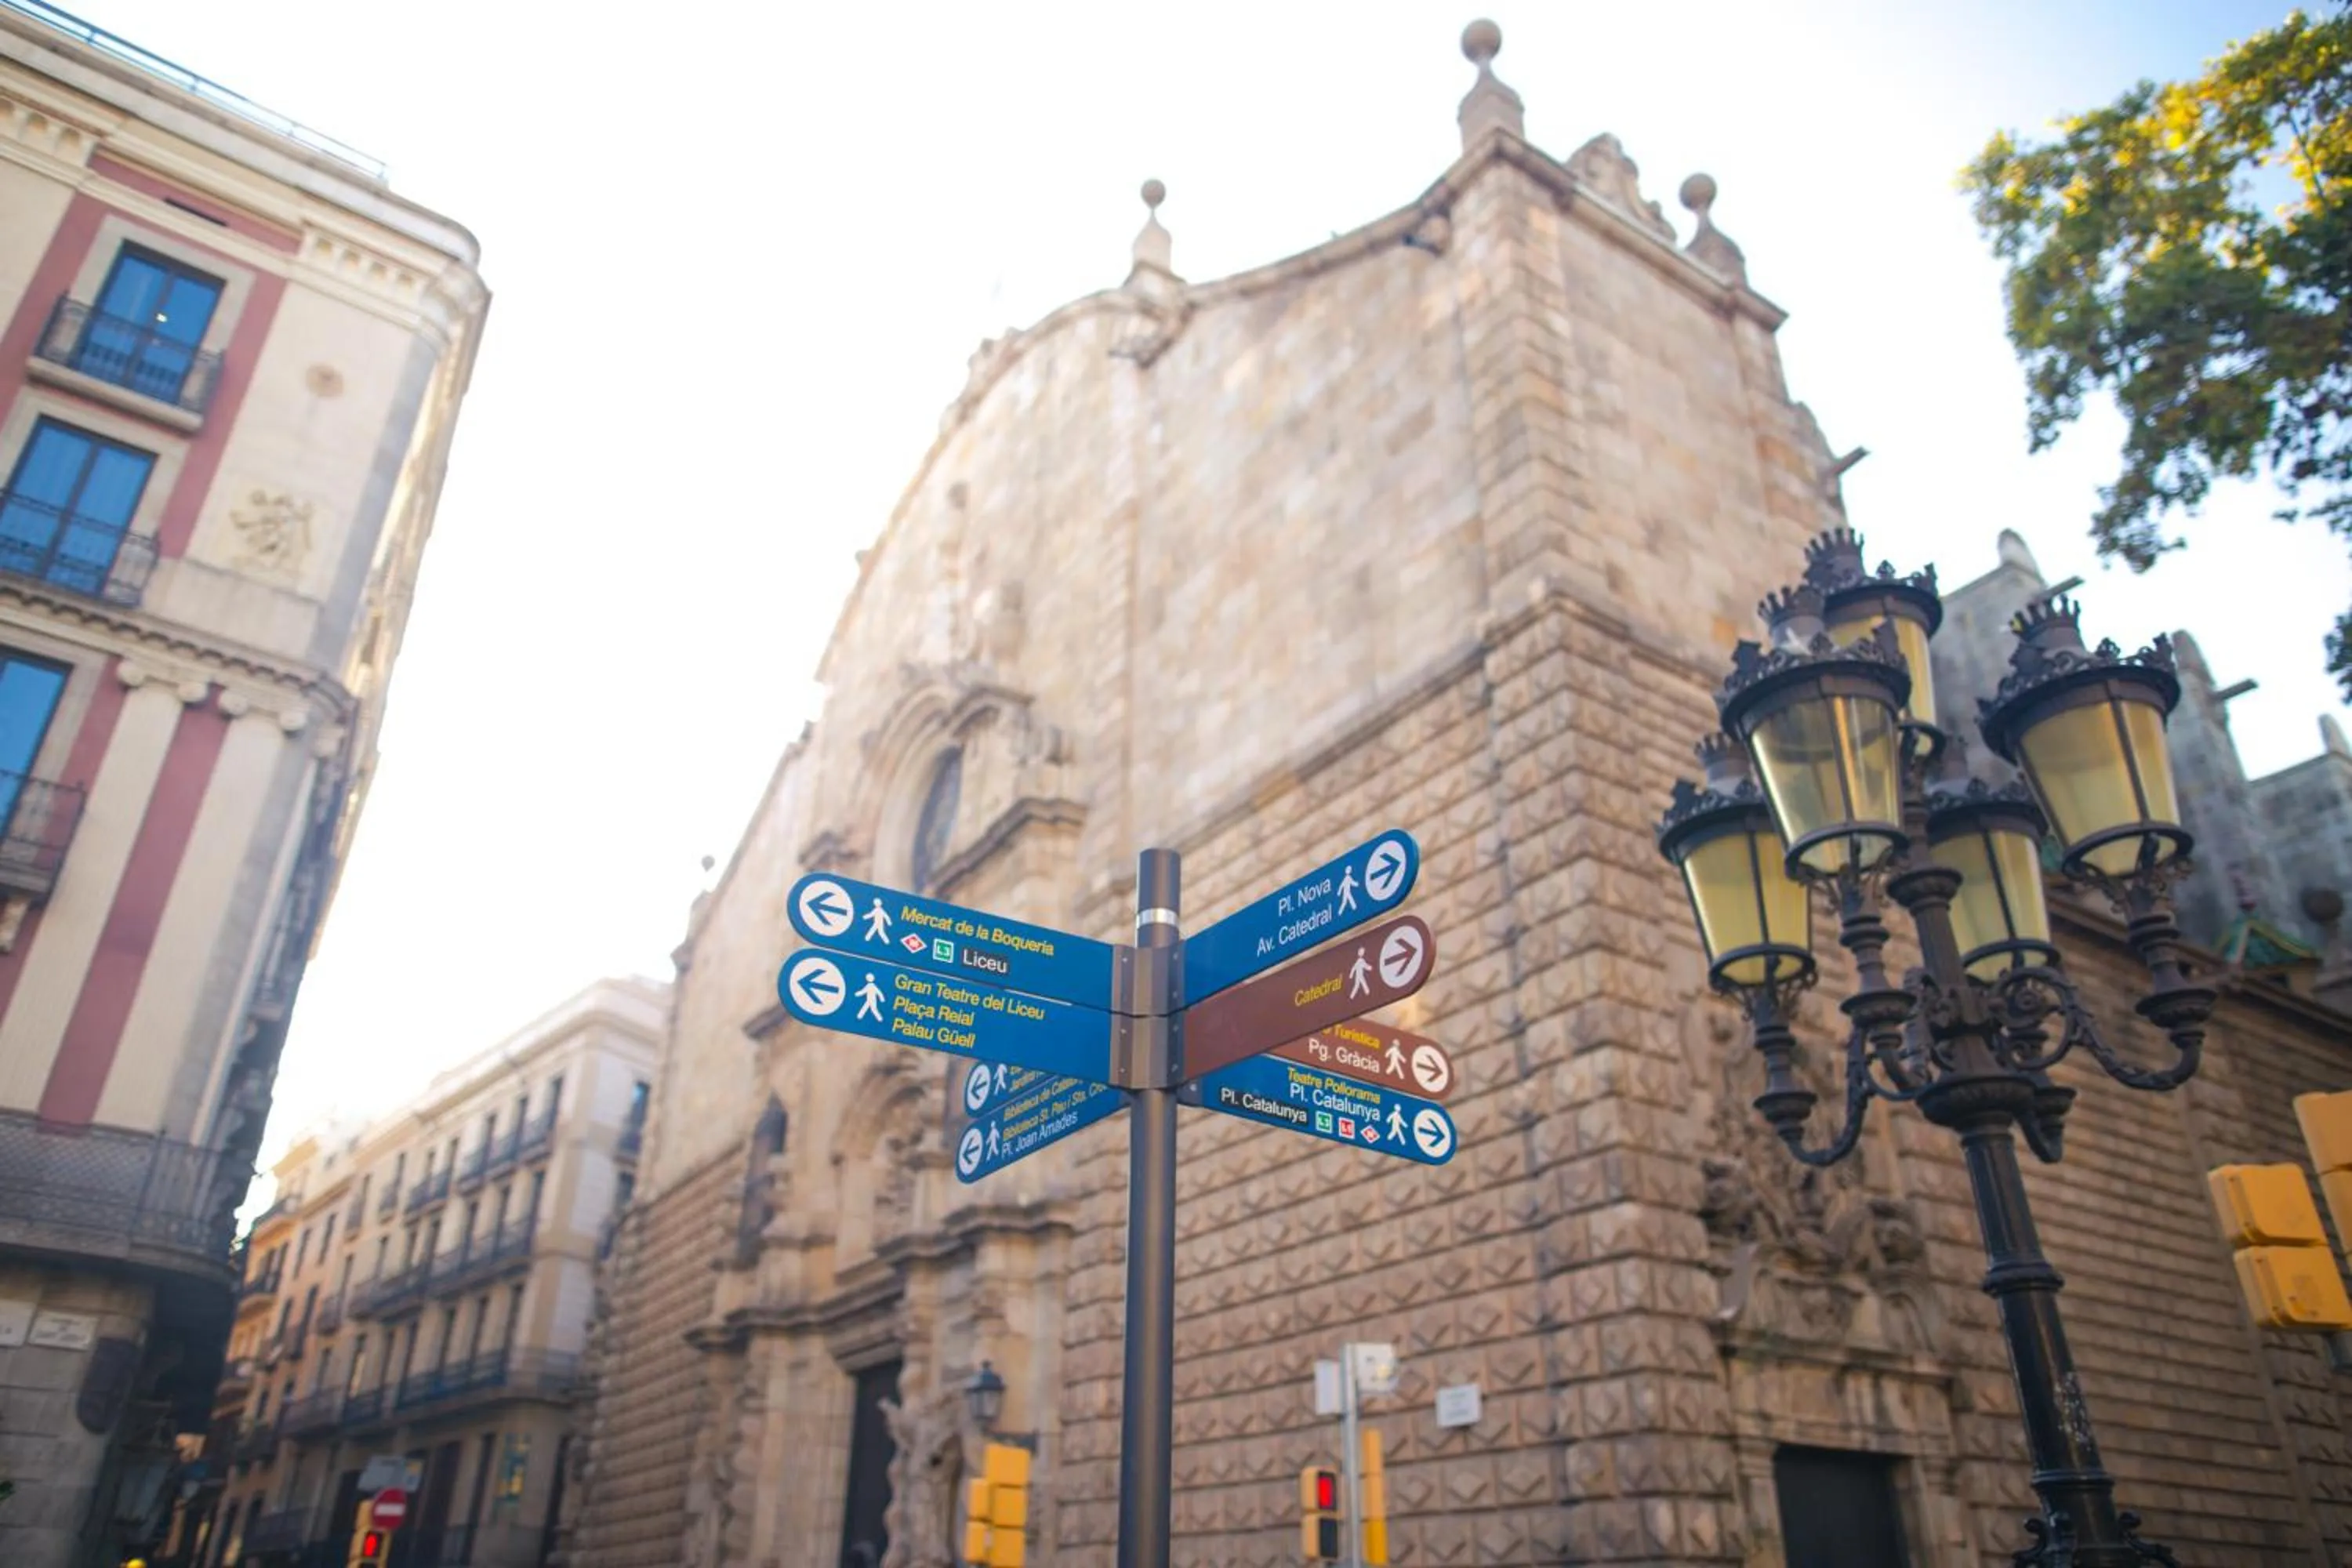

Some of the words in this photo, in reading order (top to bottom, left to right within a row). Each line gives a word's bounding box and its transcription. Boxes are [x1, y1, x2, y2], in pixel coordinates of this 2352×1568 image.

[1279, 895, 1294, 916] Pl.
[1298, 878, 1331, 907] Nova
[901, 906, 953, 931] Mercat
[955, 920, 974, 936] de
[975, 924, 989, 940] la
[992, 928, 1054, 956] Boqueria
[1257, 937, 1275, 957] Av.
[1279, 903, 1332, 945] Catedral
[963, 949, 1007, 973] Liceu
[895, 974, 932, 995] Gran
[936, 982, 979, 1006] Teatre
[982, 994, 1005, 1011] del
[1007, 998, 1045, 1020] Liceu
[1294, 975, 1343, 1007] Catedral
[893, 995, 935, 1020] Plaça
[938, 1005, 975, 1026] Reial
[891, 1018, 935, 1040] Palau
[1308, 1037, 1332, 1061] Pg.
[1335, 1046, 1380, 1073] Gràcia
[1287, 1067, 1323, 1088] Teatre
[1221, 1087, 1239, 1105] Pl.
[1242, 1093, 1308, 1123] Catalunya
[1289, 1083, 1308, 1102] Pl.
[1312, 1089, 1381, 1122] Catalunya
